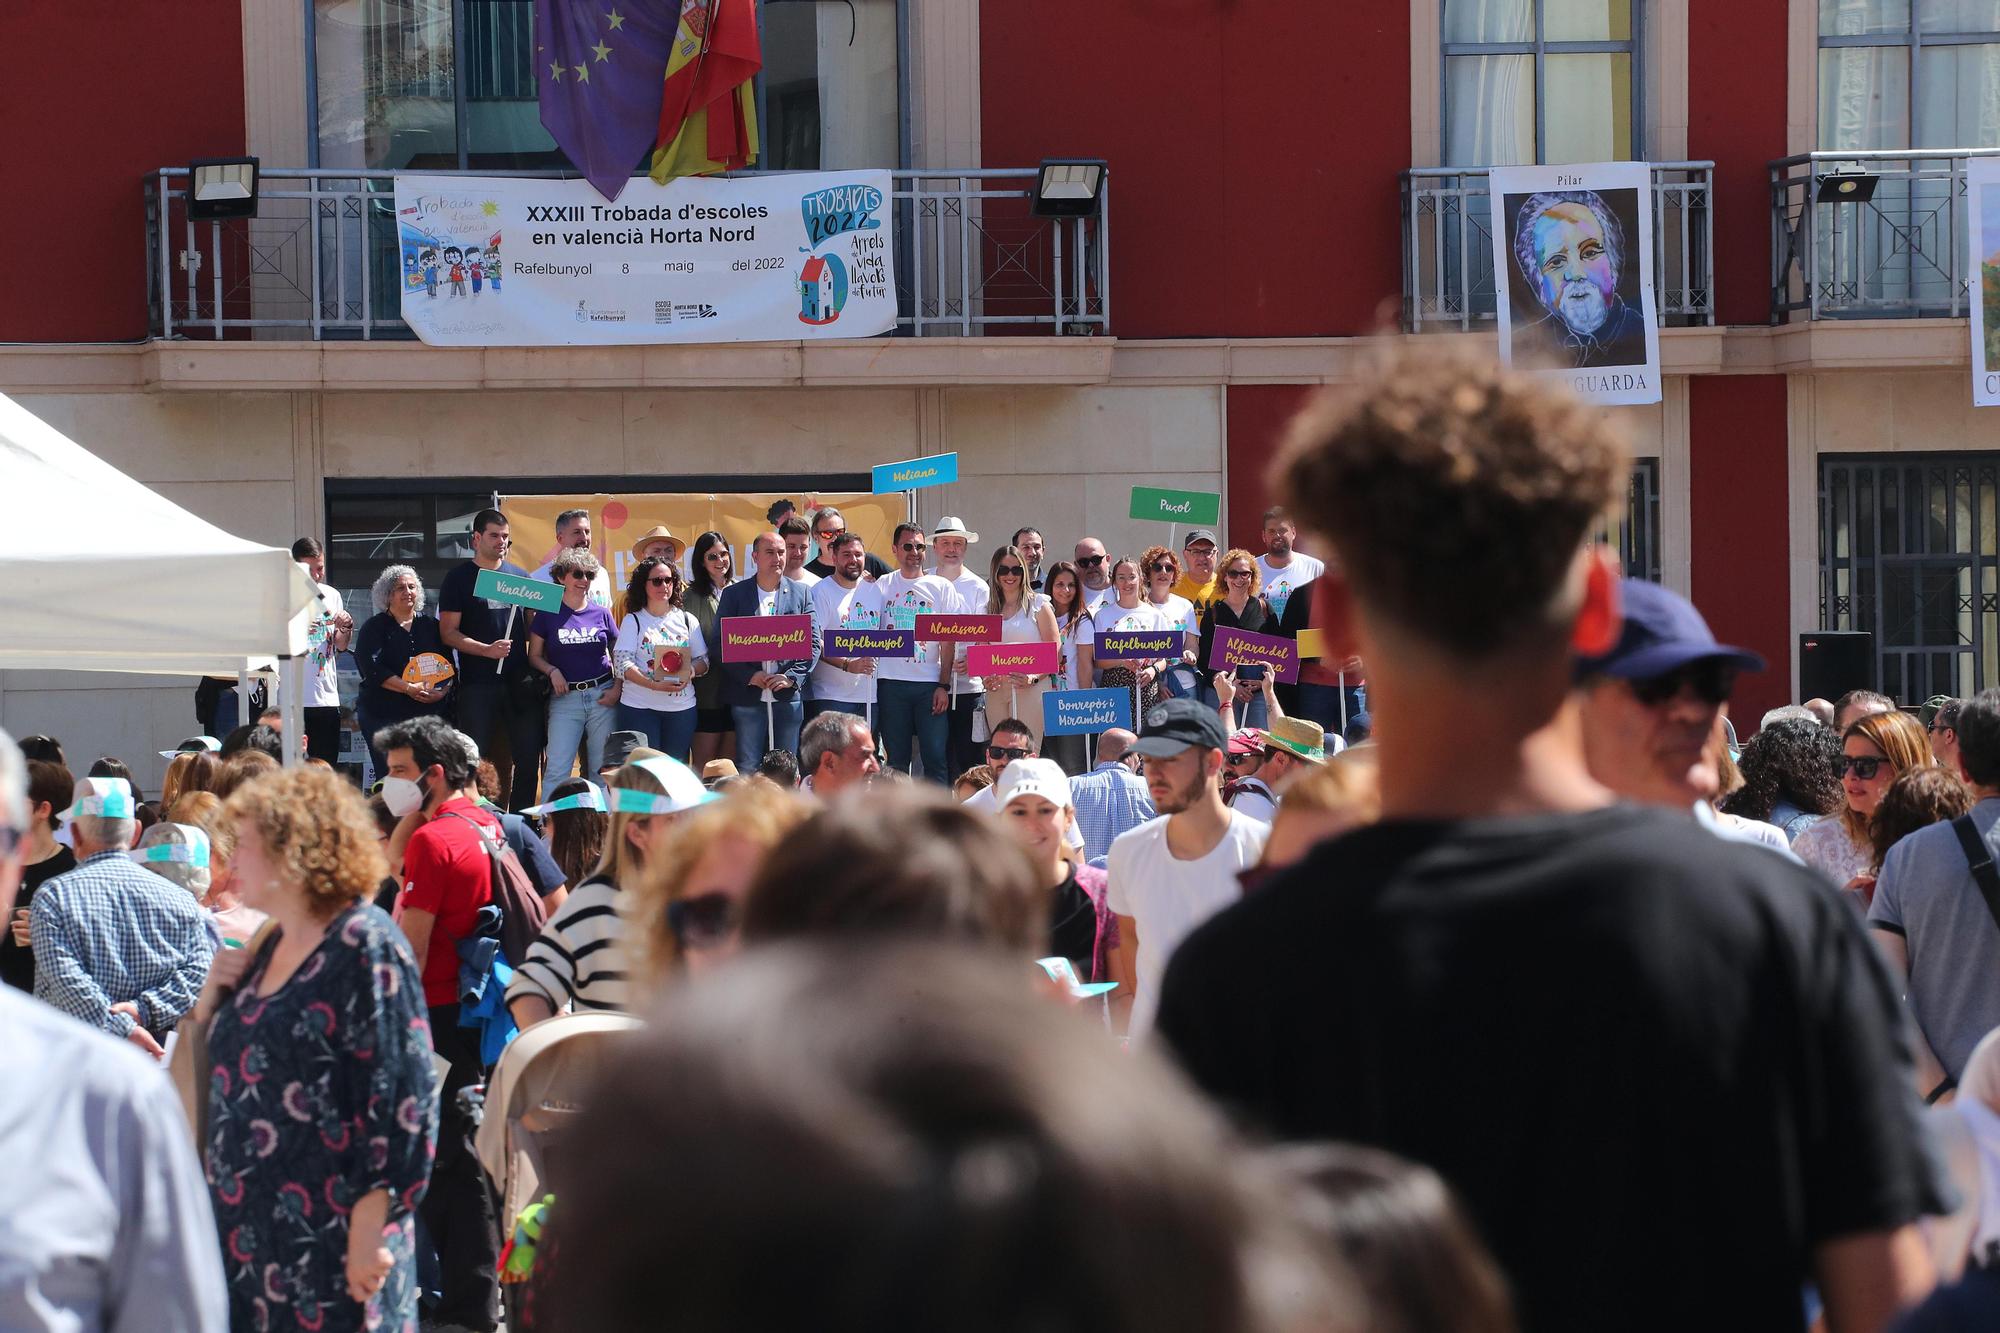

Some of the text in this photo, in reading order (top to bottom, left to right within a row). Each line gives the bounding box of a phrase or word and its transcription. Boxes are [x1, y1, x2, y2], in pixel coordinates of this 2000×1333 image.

[1557, 176, 1583, 186] Pilar
[802, 186, 880, 216] TROBADES
[526, 203, 769, 222] XXXIII Trobada d'escoles
[532, 226, 755, 245] en valencià Horta Nord
[811, 212, 868, 243] 2022
[851, 232, 884, 256] Arrels
[513, 257, 785, 278] Rafelbunyol 8 maig del 2022
[851, 265, 886, 284] llavors
[858, 284, 886, 300] futur
[1566, 374, 1647, 393] GUARDA
[893, 468, 938, 482] Meliana
[496, 580, 544, 600] Vinalesa
[727, 630, 807, 648] Massamagrell
[835, 635, 905, 652] Rafelbunyol
[1105, 636, 1174, 654] Rafelbunyol
[1226, 637, 1289, 659] Alfara del
[991, 653, 1036, 666] Museros
[1225, 652, 1286, 673] Patria
[1058, 698, 1115, 713] Bonrepòs i
[1058, 711, 1118, 726] Mirambell
